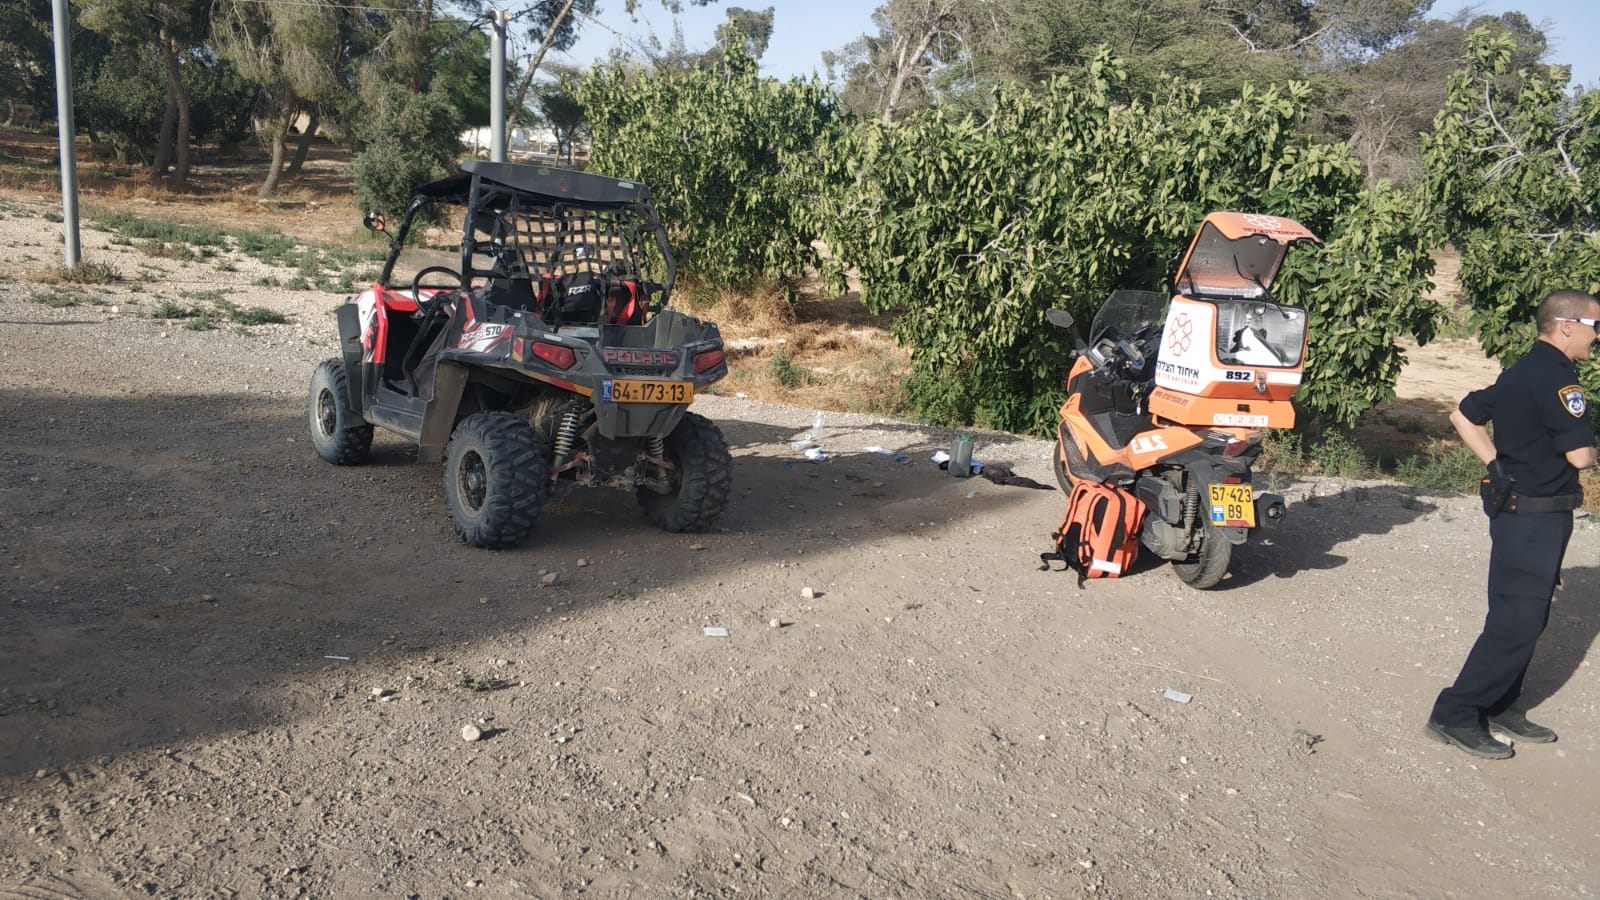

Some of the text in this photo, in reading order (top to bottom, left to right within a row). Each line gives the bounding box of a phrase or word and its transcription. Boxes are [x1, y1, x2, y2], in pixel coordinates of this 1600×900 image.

[568, 284, 591, 296] RZR
[485, 326, 502, 336] 570
[604, 351, 677, 364] POLARIS
[1156, 360, 1200, 379] איחוד הצלה
[1226, 371, 1251, 381] 892
[1227, 416, 1266, 425] 1221
[1228, 504, 1242, 519] 89
